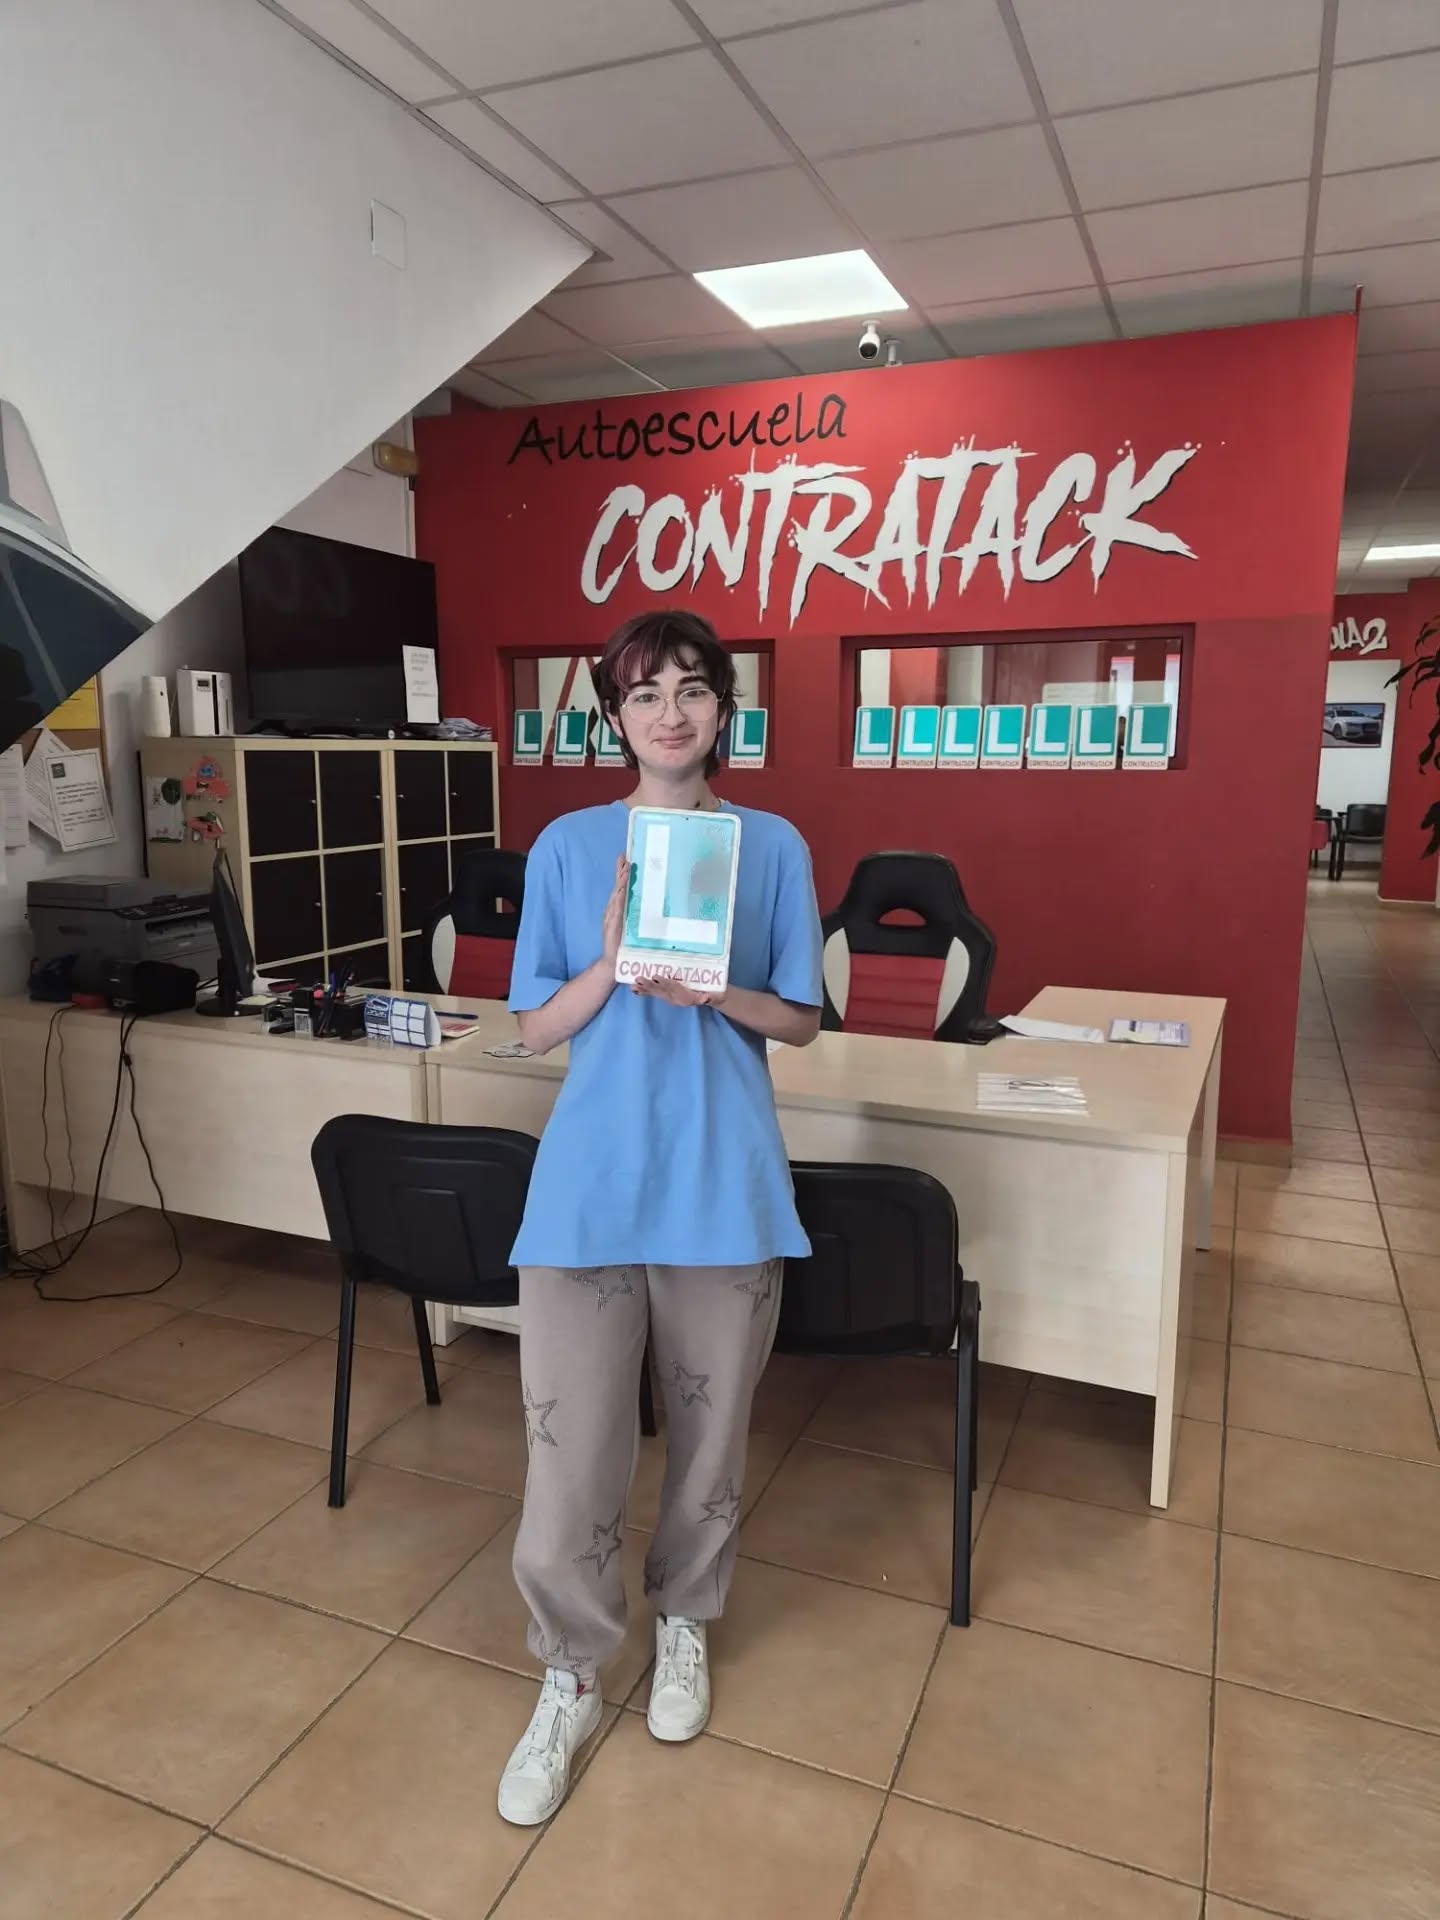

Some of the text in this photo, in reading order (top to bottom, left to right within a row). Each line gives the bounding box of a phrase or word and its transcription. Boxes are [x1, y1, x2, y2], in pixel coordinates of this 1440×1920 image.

[507, 392, 847, 466] Autoescuela
[579, 434, 1201, 630] CONTRATACK
[517, 713, 540, 752] L
[558, 714, 583, 752] L
[734, 712, 762, 752] L
[860, 711, 888, 753] L
[902, 710, 931, 753] L
[943, 710, 974, 753] L
[987, 710, 1018, 753] L
[1034, 709, 1066, 752] L
[1079, 709, 1111, 753] L
[1129, 709, 1164, 753] L
[638, 824, 719, 944] L
[618, 960, 723, 986] CONTRATACK
